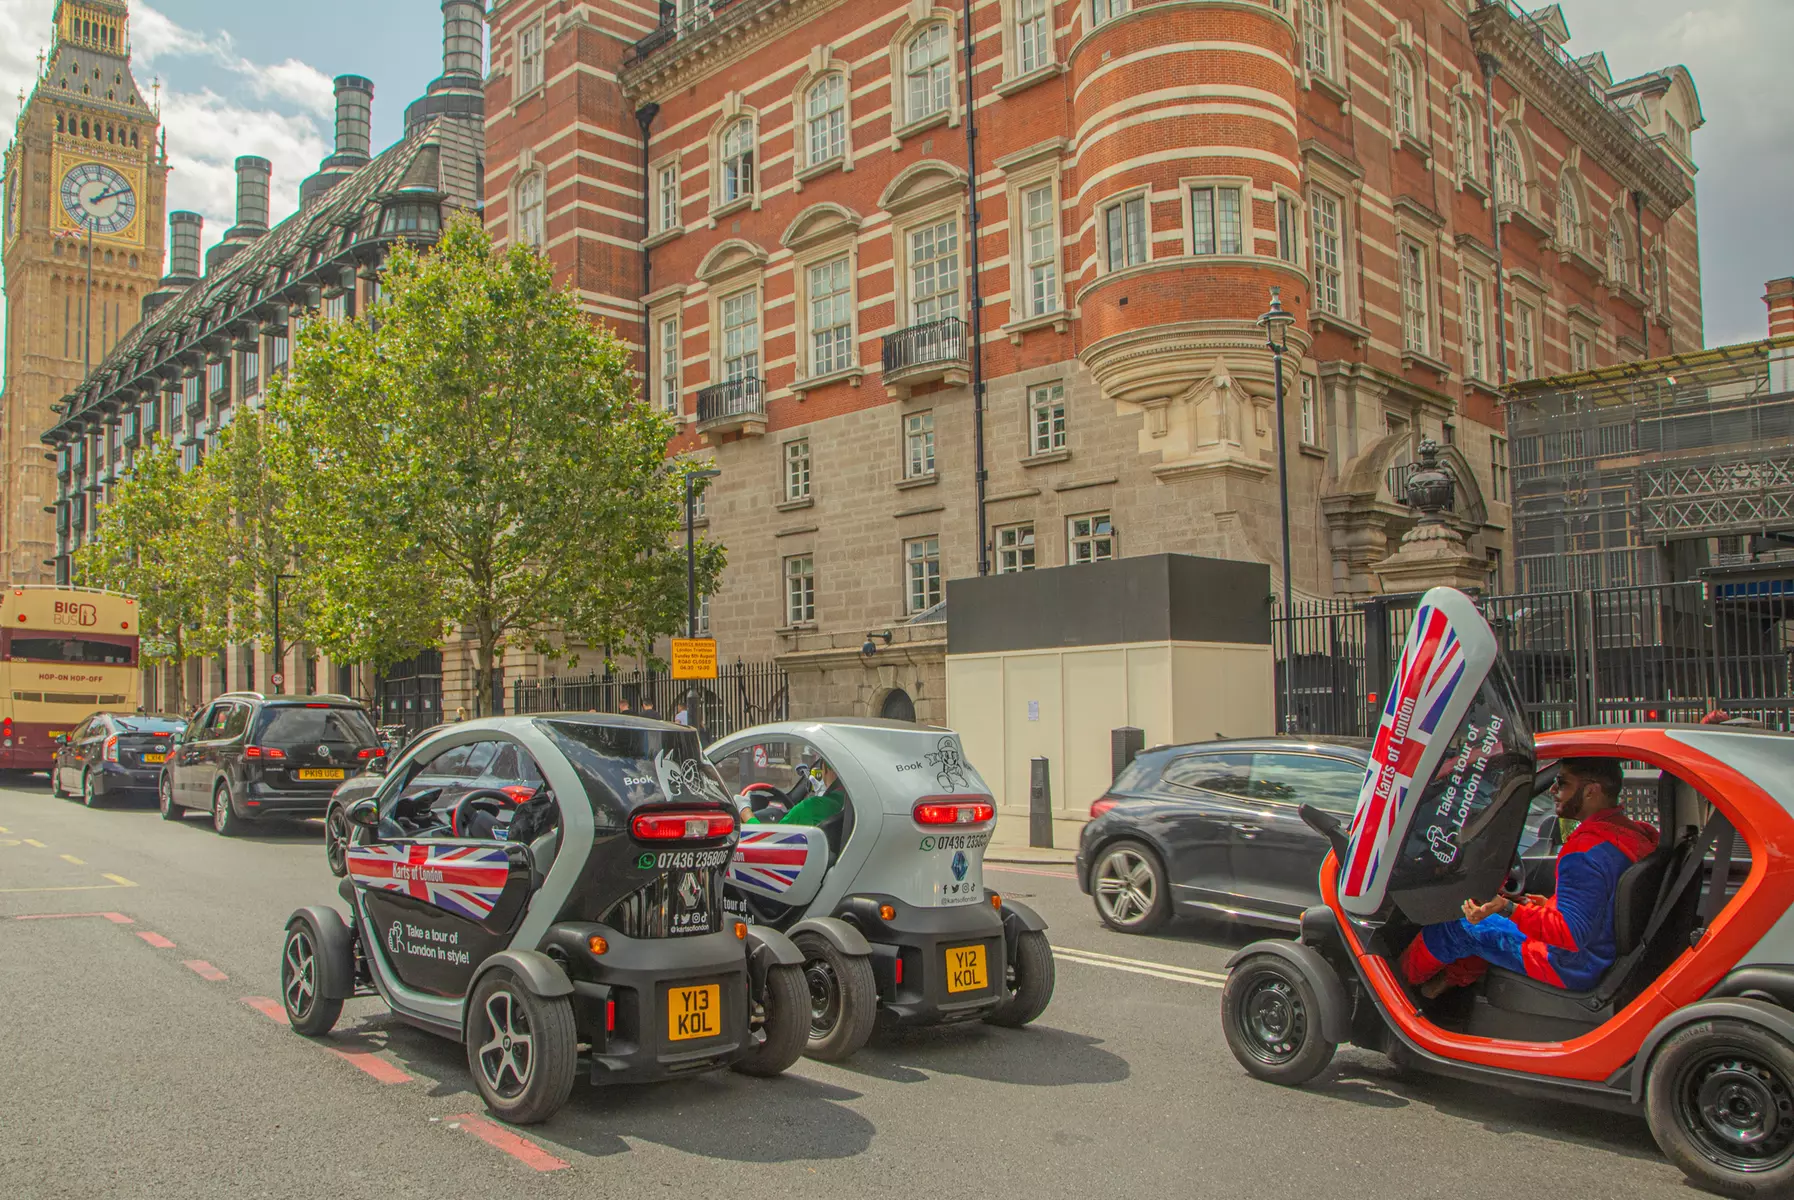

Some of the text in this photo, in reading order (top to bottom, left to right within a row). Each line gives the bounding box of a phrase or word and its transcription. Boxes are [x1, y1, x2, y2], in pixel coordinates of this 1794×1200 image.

[54, 601, 78, 614] BIG
[54, 614, 77, 625] BUS
[1376, 696, 1415, 800] Karts of London
[304, 770, 321, 778] PK19
[896, 761, 923, 772] Book
[1436, 724, 1480, 817] Take a tour of
[1452, 714, 1504, 828] London in style!
[624, 775, 654, 786] Book
[938, 836, 965, 849] 07436
[658, 850, 728, 868] 07436 235806
[393, 863, 443, 882] Karts of London
[724, 896, 746, 912] tour of
[941, 896, 977, 905] @kartsoflondon
[406, 924, 458, 944] Take a tour of
[671, 924, 709, 933] @kartsoflondon
[408, 942, 470, 965] London in style!
[956, 951, 976, 968] Y12
[954, 969, 981, 987] KOL
[682, 990, 708, 1012] Y13
[678, 1012, 712, 1035] KOL
